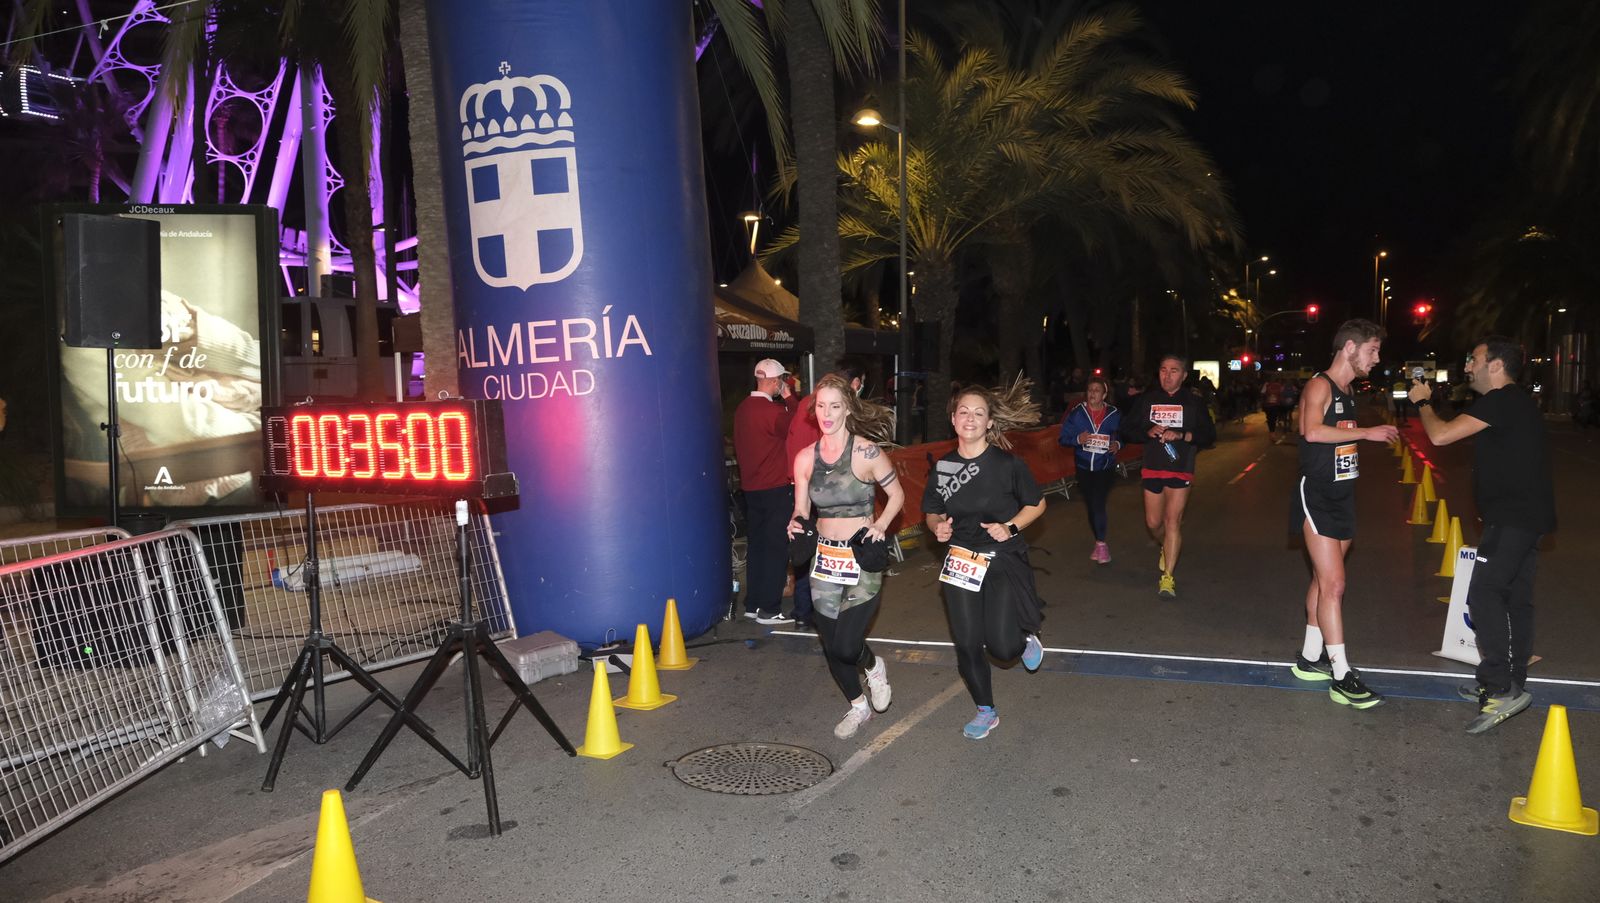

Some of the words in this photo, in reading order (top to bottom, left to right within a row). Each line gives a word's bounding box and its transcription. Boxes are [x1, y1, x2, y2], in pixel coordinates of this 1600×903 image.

[128, 205, 175, 214] JCDecaux
[168, 230, 178, 238] de
[178, 230, 213, 238] Andalucía
[458, 304, 653, 369] ALMERÍA
[114, 353, 154, 369] con
[155, 346, 178, 376] f
[179, 346, 208, 369] de
[115, 373, 214, 404] futuro
[483, 368, 596, 401] CIUDAD
[822, 557, 854, 571] 3374
[948, 559, 978, 576] 3361
